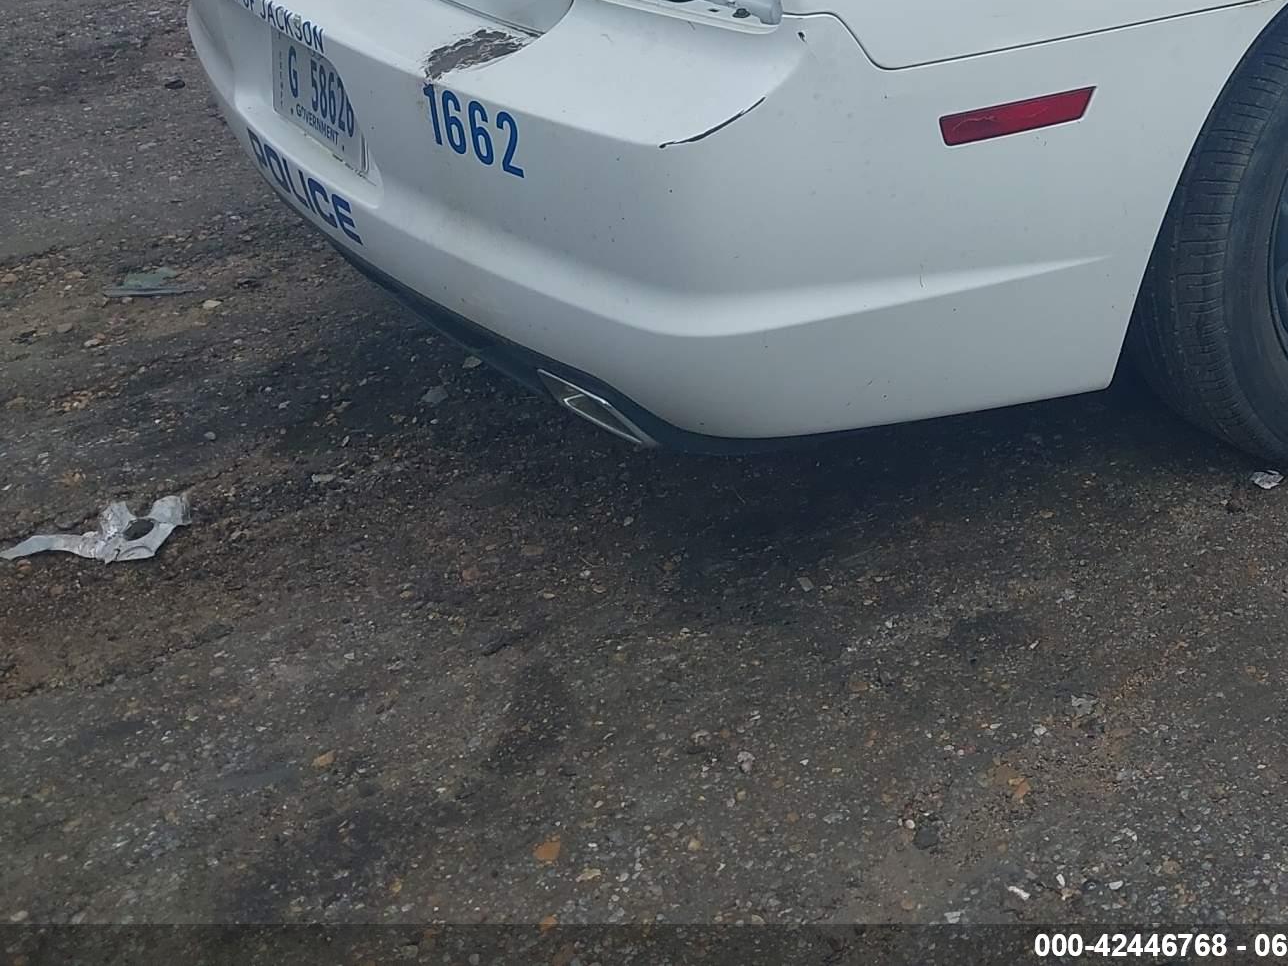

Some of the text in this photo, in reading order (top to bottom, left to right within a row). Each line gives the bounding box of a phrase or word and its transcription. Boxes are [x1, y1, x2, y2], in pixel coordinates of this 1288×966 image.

[288, 45, 299, 99] G
[296, 103, 340, 146] GOVERNMENT
[422, 82, 525, 179] 1662
[247, 127, 364, 246] POLICE
